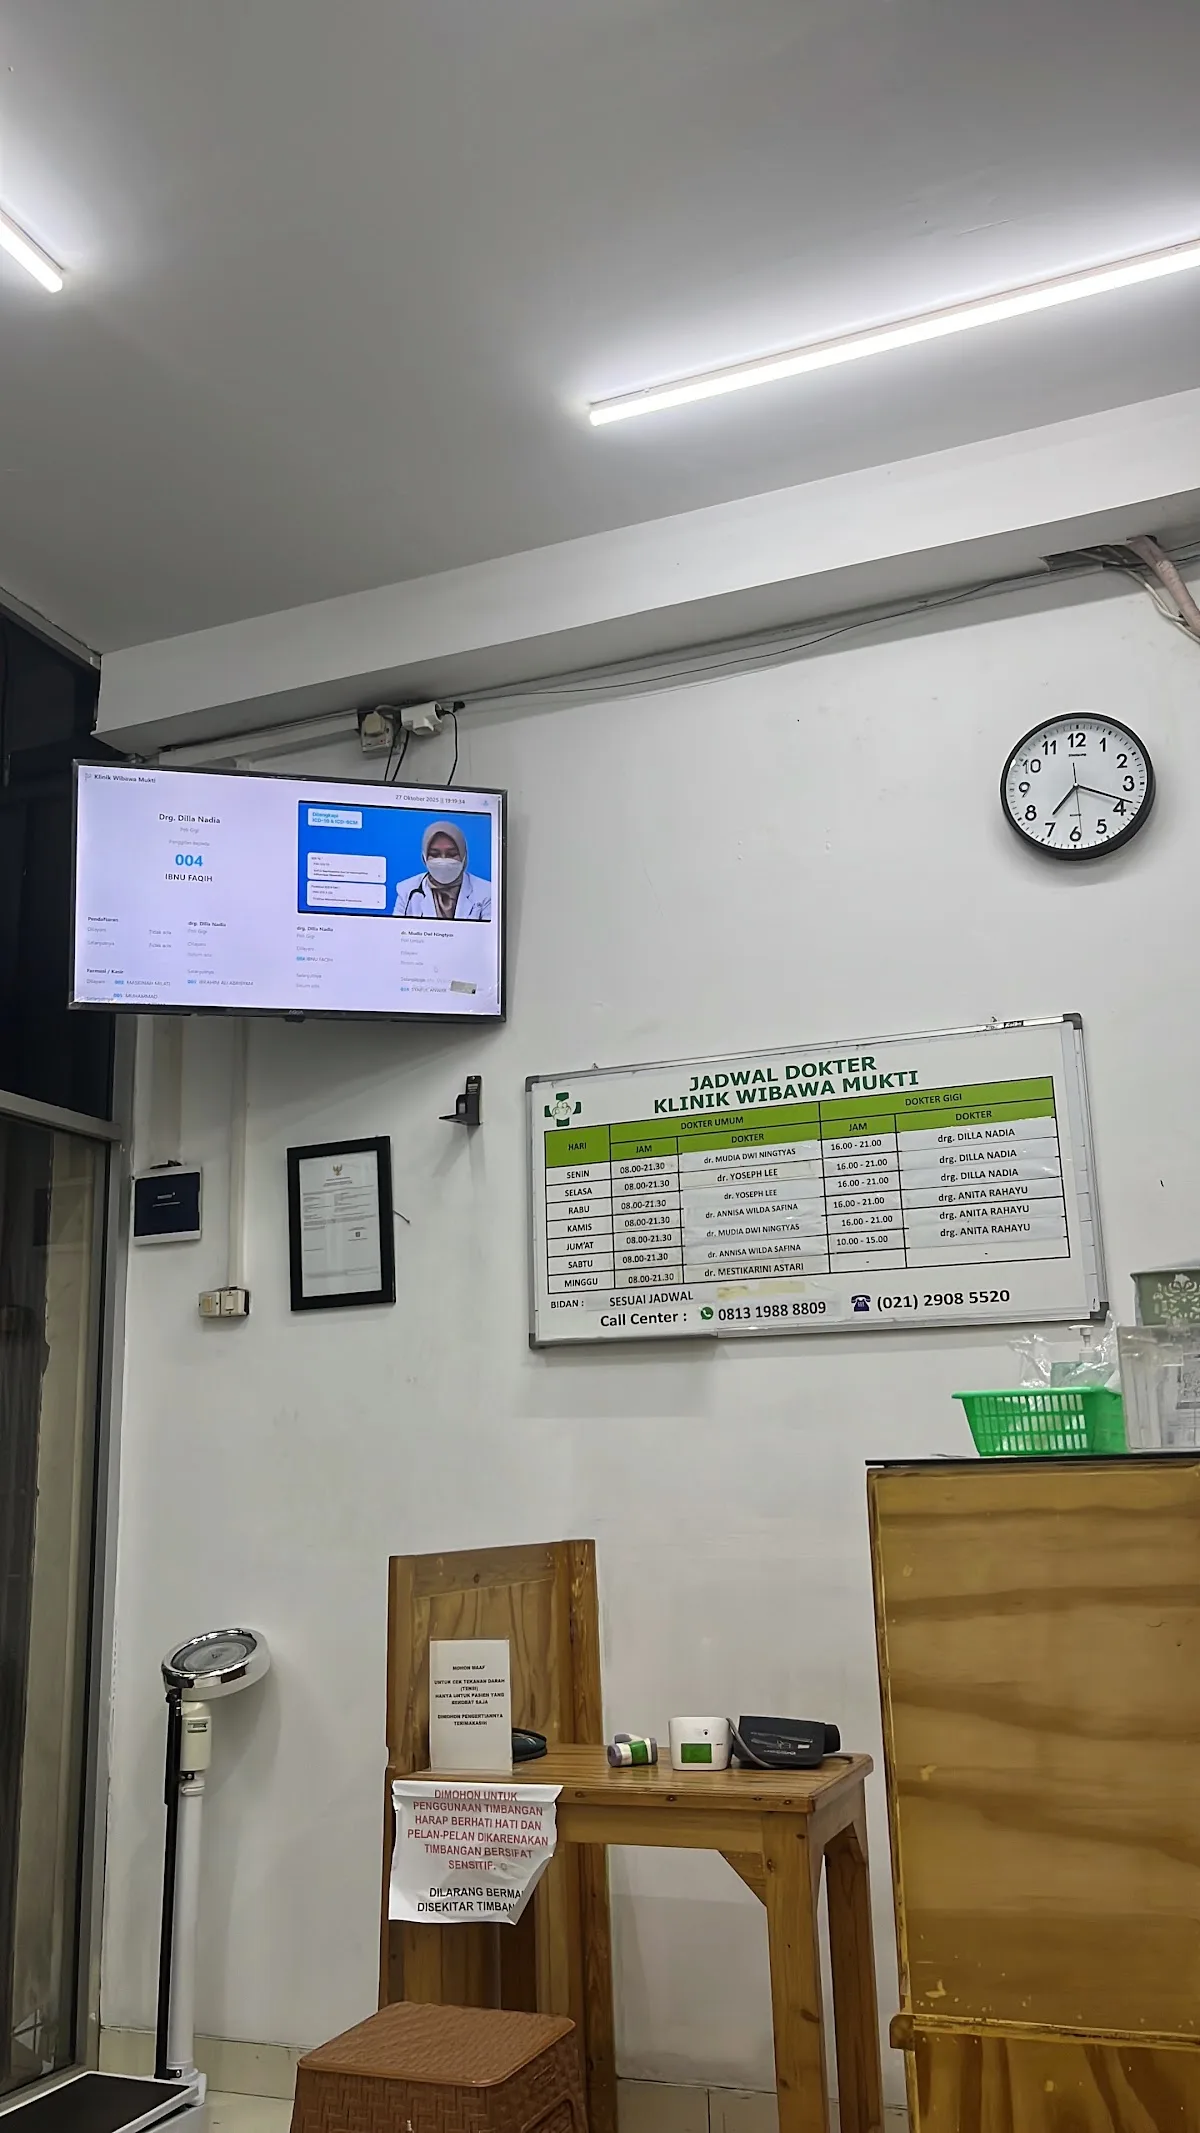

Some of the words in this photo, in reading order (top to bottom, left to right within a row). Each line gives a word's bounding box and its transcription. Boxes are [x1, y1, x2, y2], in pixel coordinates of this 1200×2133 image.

[1068, 732, 1086, 748] 12
[1100, 738, 1106, 752] 1
[1042, 740, 1056, 755] 11
[1023, 759, 1041, 774] 10
[1117, 754, 1127, 768] 2
[1123, 776, 1135, 791] 3
[1019, 782, 1030, 797] 9
[1025, 805, 1037, 821] 8
[1113, 799, 1126, 816] 4
[159, 814, 175, 822] Drg.
[1045, 823, 1056, 837] 7
[1096, 819, 1107, 834] 5
[1070, 826, 1081, 841] 6
[175, 854, 203, 866] 004
[188, 874, 212, 882] FAQIH
[690, 1068, 778, 1091] JADWAL
[786, 1056, 877, 1080] DOKTER
[654, 1092, 729, 1113] KLINIK
[736, 1080, 835, 1102] WIBAWA
[843, 1070, 919, 1092] MUKTI
[906, 1095, 940, 1106] DOKTER
[943, 1093, 962, 1102] GIGI
[956, 1110, 992, 1120] DOKTER
[681, 1119, 713, 1130] DOKTER
[715, 1116, 743, 1126] UMUM
[849, 1123, 867, 1131] JAM
[732, 1133, 764, 1144] DOKTER
[938, 1135, 954, 1143] drg.
[958, 1132, 982, 1140] DILLA
[985, 1128, 1015, 1138] NADIA
[568, 1142, 586, 1150] HARI
[636, 1145, 652, 1153] JAM
[860, 1140, 881, 1148] 21.00
[759, 1148, 795, 1158] NINGTYAS
[940, 1156, 956, 1164] drg.
[960, 1153, 984, 1162] DILLA
[987, 1150, 1017, 1159] NADIA
[620, 1162, 665, 1174] 08.00-21.30
[837, 1162, 858, 1170] 16.00
[866, 1159, 887, 1167] 21.00
[567, 1170, 589, 1178] SENIN
[730, 1170, 761, 1180] YOSEPH
[941, 1174, 958, 1182] drg.
[961, 1171, 985, 1179] DILLA
[989, 1168, 1018, 1178] NADIA
[625, 1180, 669, 1190] 08.00-21.30
[838, 1180, 859, 1188] 16.00
[867, 1177, 888, 1185] 21.00
[565, 1188, 592, 1196] SELASA
[939, 1194, 955, 1202] drg.
[958, 1190, 986, 1200] ANITA
[989, 1186, 1028, 1197] RAHAYU
[621, 1200, 666, 1209] 08.00-21.30
[834, 1200, 855, 1208] 16.00
[862, 1197, 884, 1205] 21.00
[568, 1206, 589, 1214] RABU
[717, 1208, 744, 1217] ANNISA
[746, 1206, 770, 1215] WILDA
[772, 1204, 798, 1212] SAFINA
[940, 1212, 956, 1220] drg.
[960, 1209, 988, 1218] ANITA
[991, 1205, 1029, 1215] RAHAYU
[625, 1216, 670, 1227] 08.00-21.30
[842, 1218, 863, 1226] 16.00
[871, 1215, 892, 1224] 21.00
[568, 1224, 592, 1232] KAMIS
[763, 1224, 799, 1232] NINGTYAS
[940, 1229, 957, 1238] drg.
[960, 1226, 988, 1235] ANITA
[992, 1224, 1030, 1233] RAHAYU
[626, 1234, 671, 1244] 08.00-21.30
[866, 1235, 888, 1244] 15.00
[567, 1242, 594, 1250] JUM'AT
[719, 1249, 746, 1257] ANNISA
[749, 1247, 773, 1255] WILDA
[774, 1244, 801, 1252] SAFINA
[623, 1253, 668, 1263] 08.00-21.30
[568, 1260, 592, 1268] SABTU
[718, 1265, 771, 1275] MESTIKARINI
[774, 1263, 803, 1272] ASTARI
[565, 1278, 598, 1287] MINGGU
[628, 1273, 674, 1283] 08.00-21.30
[551, 1300, 578, 1309] BIDAN
[609, 1294, 646, 1307] SESUAI
[649, 1291, 693, 1304] JADWAL
[601, 1314, 626, 1327] Call
[631, 1312, 678, 1325] Center
[719, 1305, 750, 1321] 0813
[756, 1303, 788, 1319] 1988
[793, 1302, 826, 1315] 8809
[877, 1294, 919, 1312] (021)
[924, 1291, 963, 1307] 2908
[969, 1289, 1010, 1303] 5520
[435, 1790, 480, 1800] DIMOHON
[484, 1791, 517, 1800] UNTUK
[414, 1802, 481, 1812] PENGGUNAAN
[485, 1804, 543, 1816] TIMBANGAN
[415, 1816, 448, 1825] HARAP
[452, 1817, 492, 1827] BERHATI
[495, 1819, 517, 1829] HATI
[521, 1820, 541, 1830] DAN
[408, 1829, 474, 1841] PELAN-PELAN
[478, 1833, 548, 1845] DIKARENAKAN
[425, 1844, 481, 1855] TIMBANGAN
[485, 1846, 532, 1858] BERSIFAT
[449, 1860, 496, 1870] SENSITIF.
[430, 1887, 483, 1897] DILARANG
[418, 1902, 474, 1912] DISEKITAR
